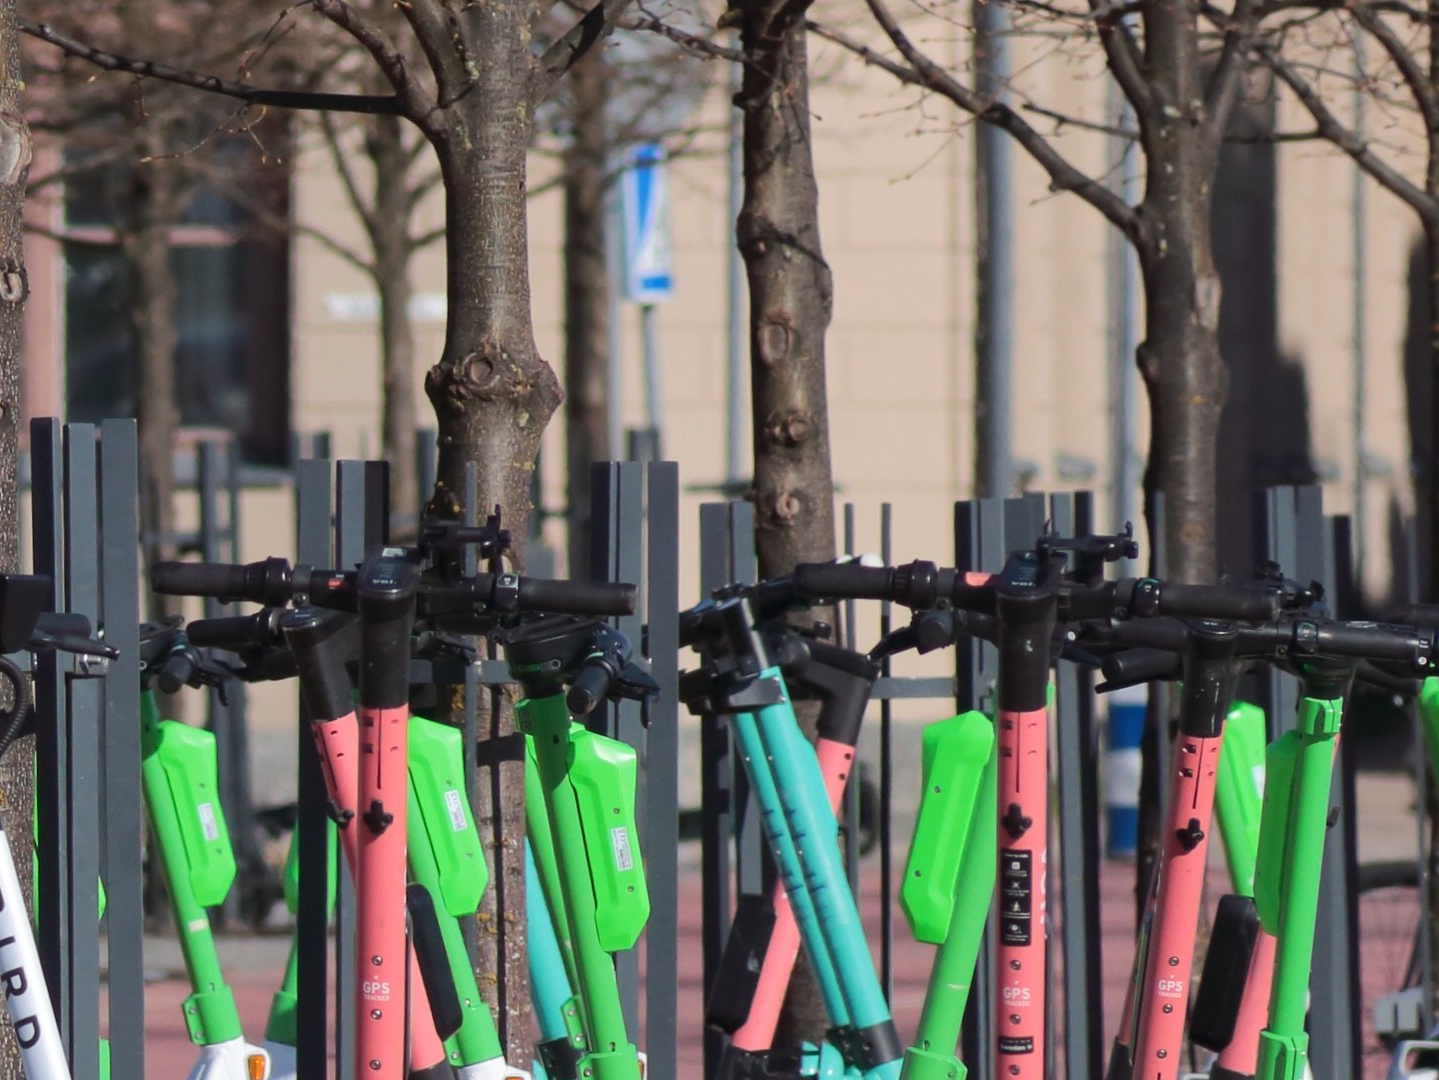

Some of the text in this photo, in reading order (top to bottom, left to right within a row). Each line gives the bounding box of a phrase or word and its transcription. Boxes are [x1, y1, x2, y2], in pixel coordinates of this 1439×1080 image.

[363, 981, 390, 994] GPS
[1158, 980, 1183, 992] GPS
[1003, 986, 1031, 1000] GPS
